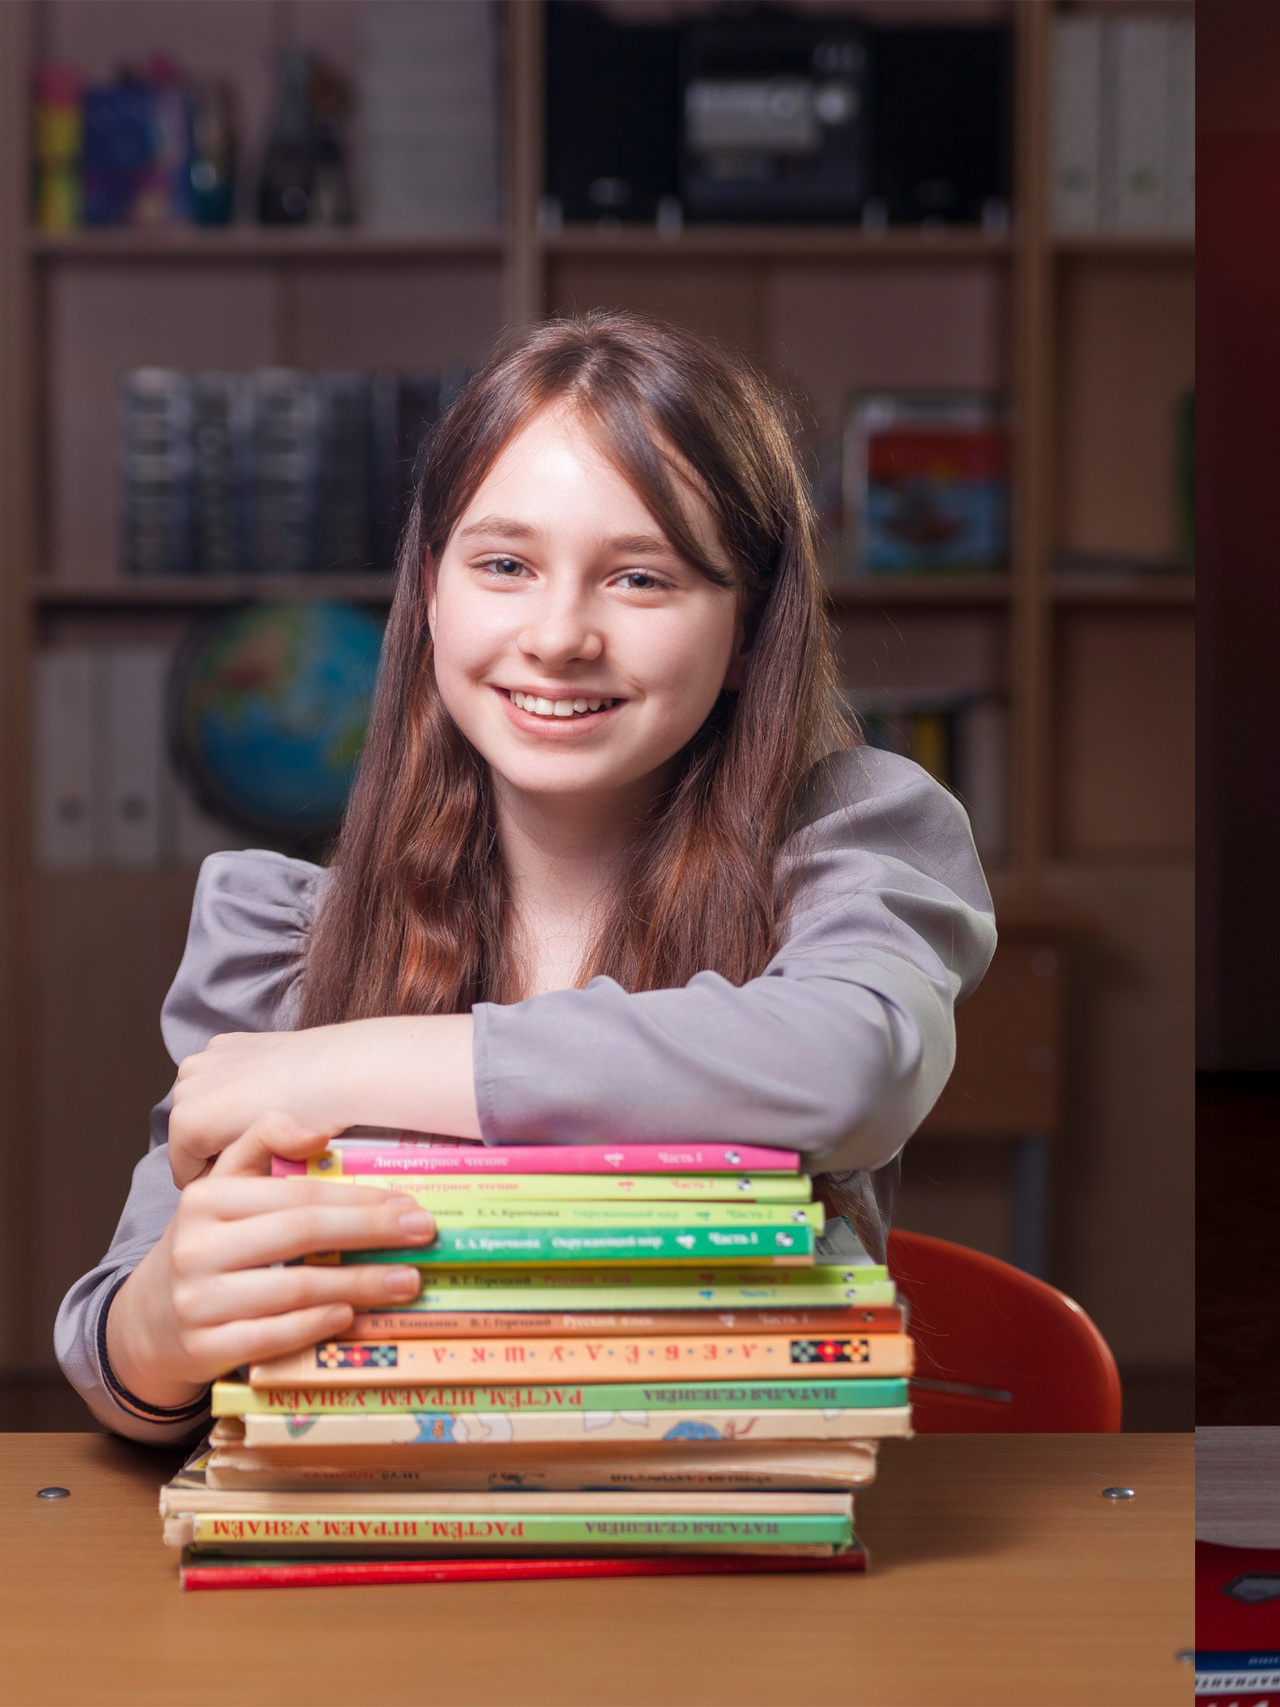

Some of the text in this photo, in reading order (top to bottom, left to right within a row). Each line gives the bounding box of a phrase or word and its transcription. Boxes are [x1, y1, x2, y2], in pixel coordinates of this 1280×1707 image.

[373, 1155, 461, 1170] Литературное
[464, 1156, 508, 1167] чтение
[658, 1152, 694, 1164] Часть
[671, 1179, 706, 1190] Часть
[726, 1208, 762, 1220] Часть
[708, 1232, 746, 1246] Часть
[267, 1387, 836, 1410] РАСТЁМ, ИГРАЕМ, УЗНАЁМ НАТАЛЬЯ СЕЛЕЗНЁВА
[212, 1518, 779, 1540] РАСТЁМ, ИГРАЕМ, УЗНАЁМ НАТАЛЬЯ СЕЛЕЗНЁВА
